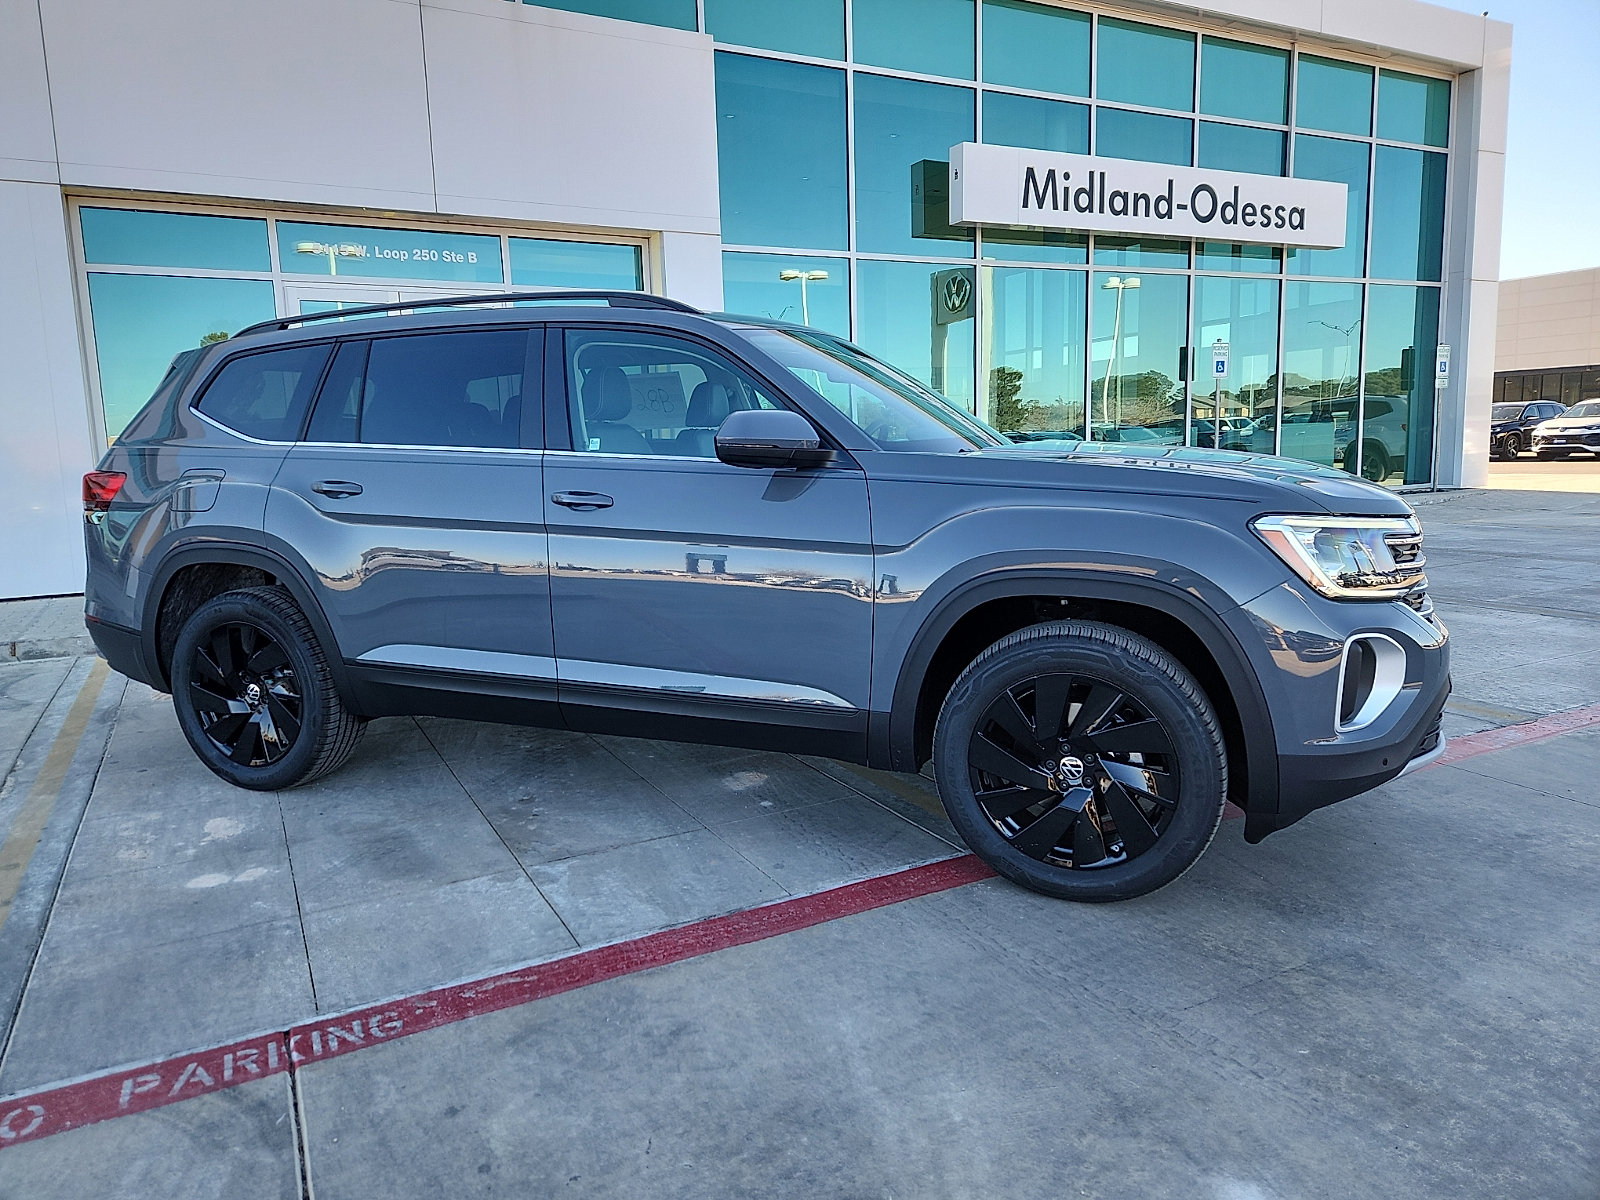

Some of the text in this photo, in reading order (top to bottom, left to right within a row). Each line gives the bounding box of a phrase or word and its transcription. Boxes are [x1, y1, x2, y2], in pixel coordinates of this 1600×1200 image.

[1021, 166, 1306, 231] Midland-Odessa
[375, 246, 409, 261] Loop
[413, 249, 438, 261] 250
[442, 251, 464, 263] Ste
[468, 252, 478, 263] B
[118, 1011, 404, 1109] PARKING
